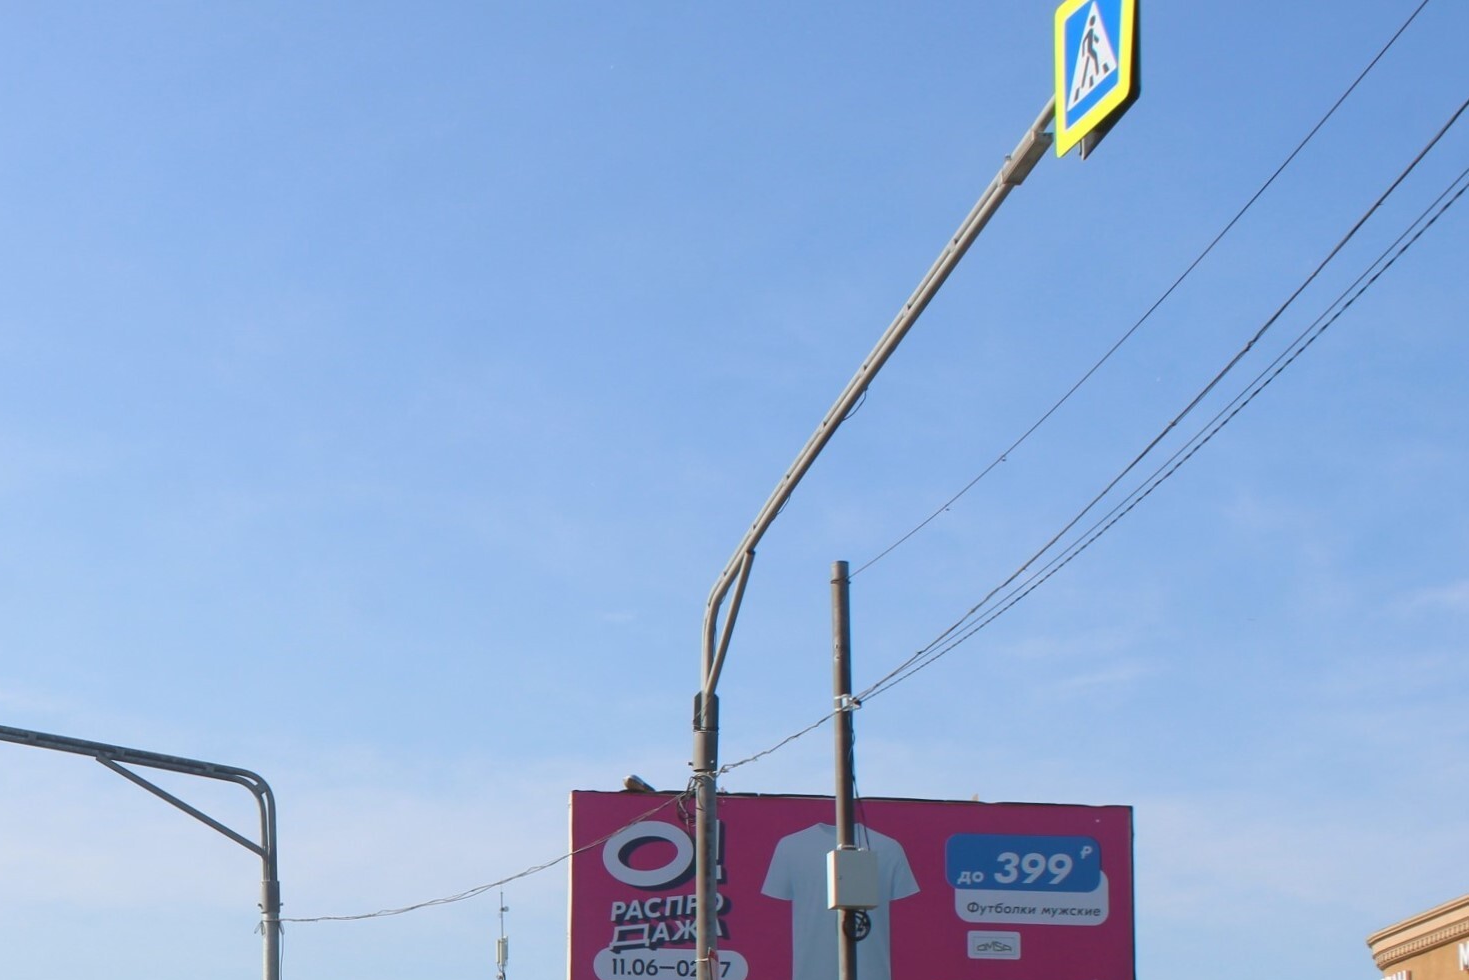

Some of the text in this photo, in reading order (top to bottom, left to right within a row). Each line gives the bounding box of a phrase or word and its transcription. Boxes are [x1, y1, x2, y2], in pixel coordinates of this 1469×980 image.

[957, 871, 984, 885] до
[994, 852, 1073, 884] 399
[967, 902, 1101, 917] Футболки мужские
